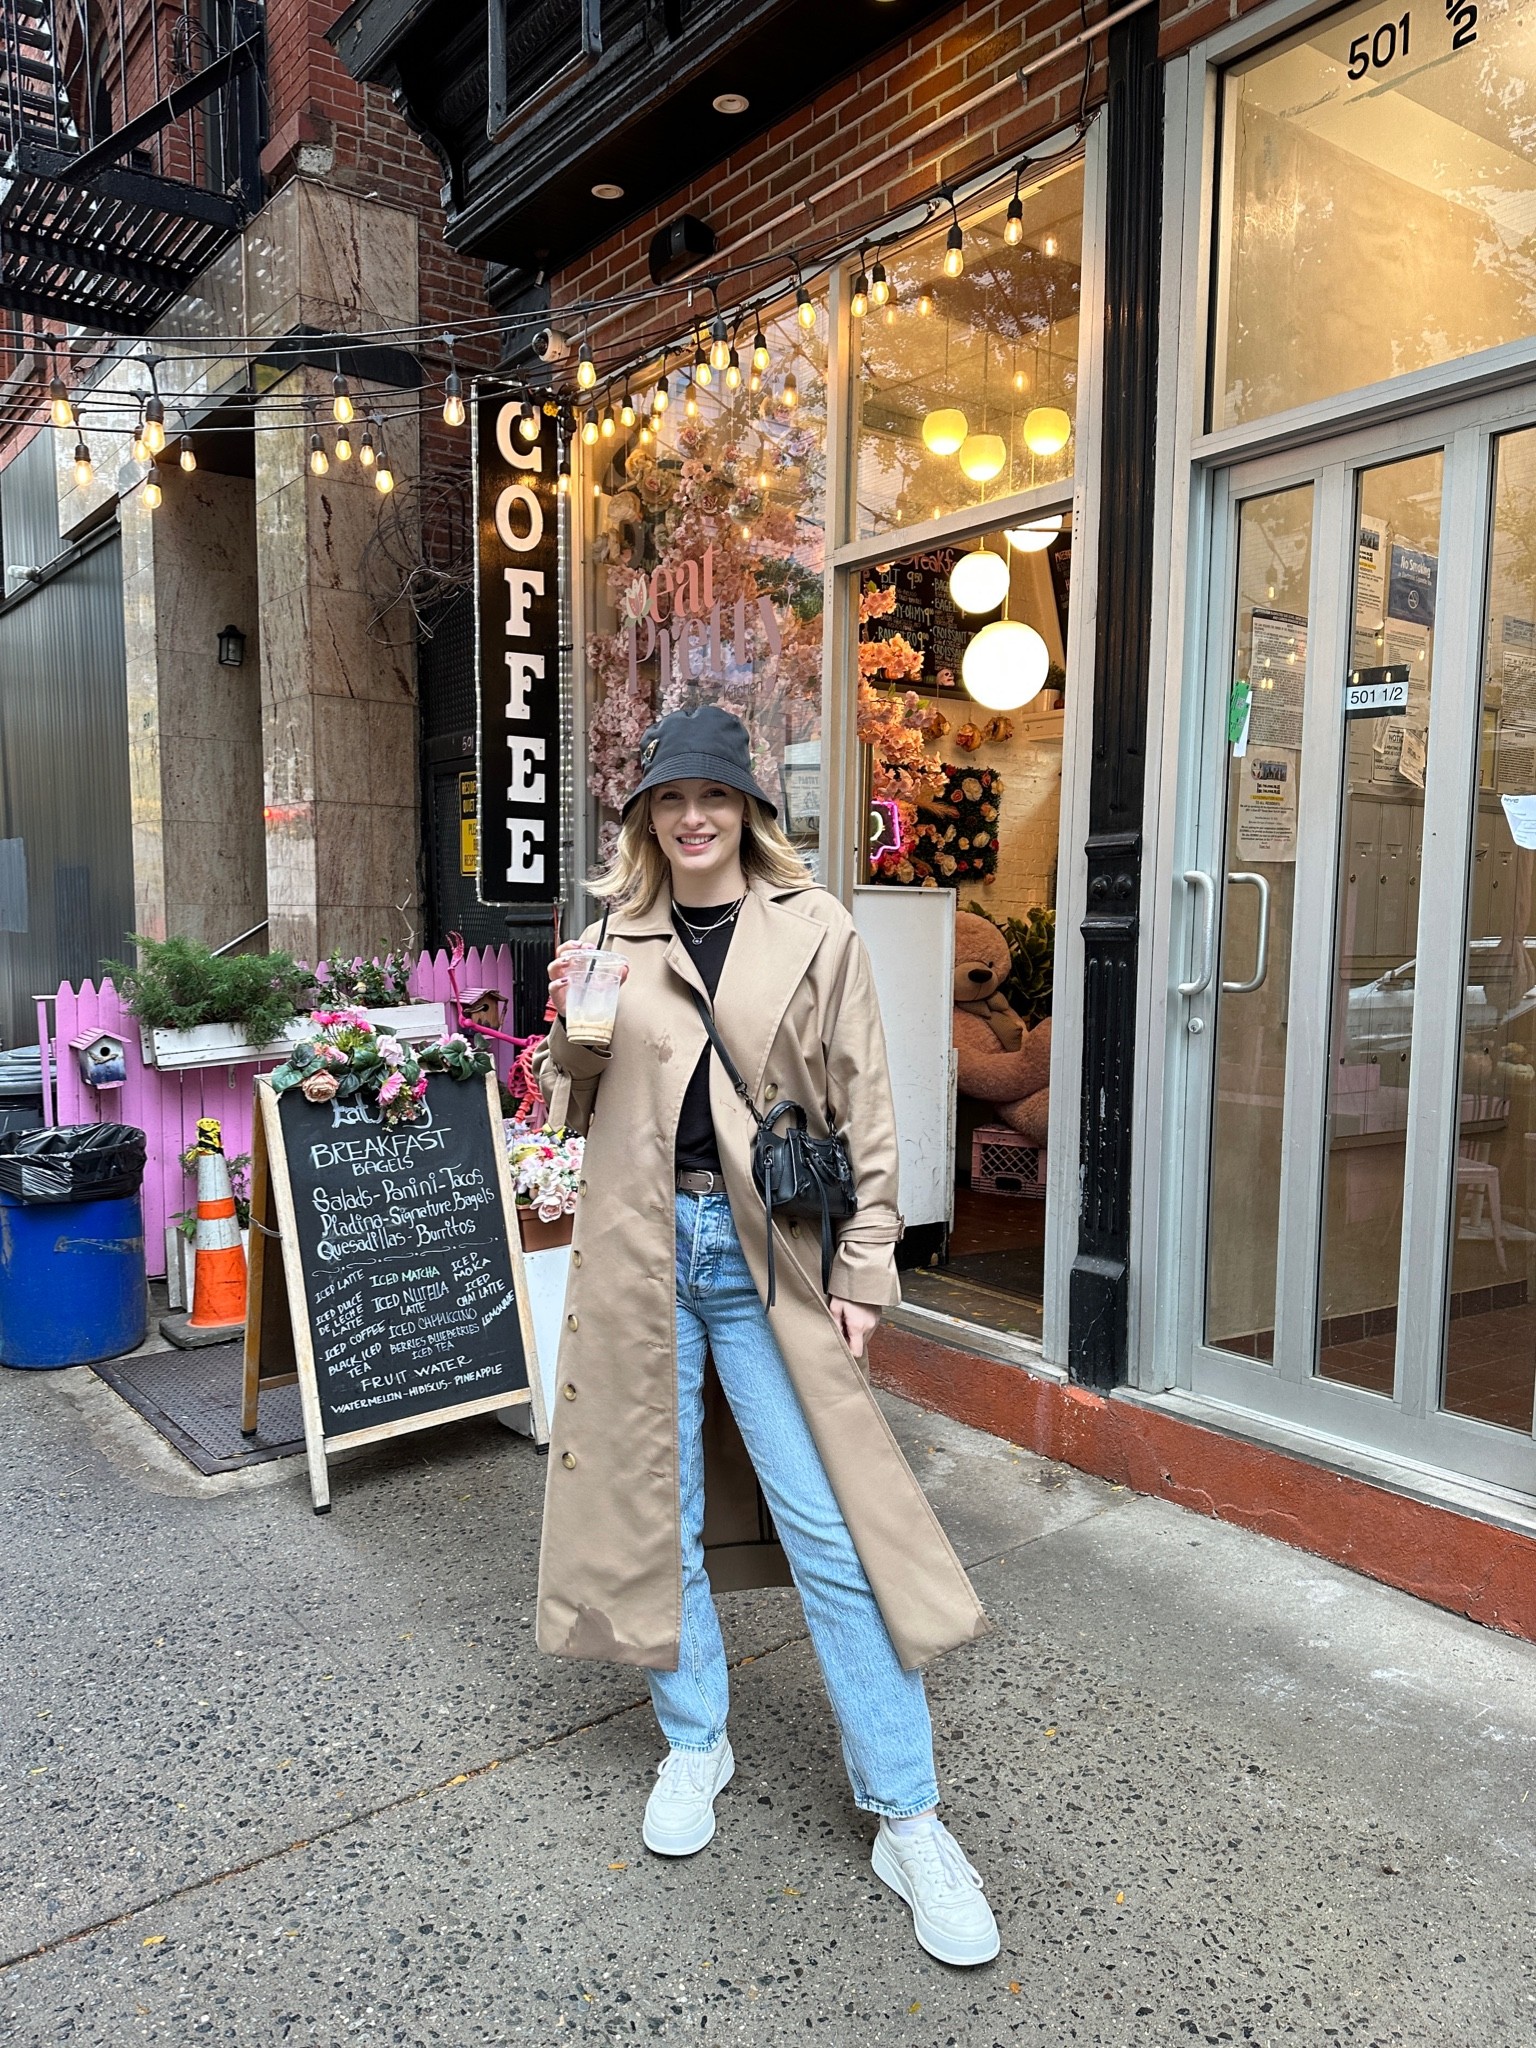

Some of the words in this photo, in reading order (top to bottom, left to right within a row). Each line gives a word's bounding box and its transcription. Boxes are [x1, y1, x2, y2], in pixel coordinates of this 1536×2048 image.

[1347, 11, 1410, 80] 501
[1446, 0, 1477, 50] /2
[649, 541, 718, 624] eat
[1409, 559, 1431, 579] Smoking
[495, 401, 546, 884] COFFEE
[627, 594, 782, 695] Pretty
[723, 680, 763, 702] Kitchen
[1350, 690, 1376, 704] 501
[1382, 687, 1403, 702] 1/2
[310, 1127, 452, 1169] BREAKFAST
[352, 1156, 414, 1177] BAGELS
[439, 1163, 484, 1189] Tacos
[389, 1200, 452, 1229] Signature
[452, 1187, 495, 1212] Bagels
[415, 1216, 476, 1247] Burritos
[451, 1252, 478, 1272] ICED
[453, 1258, 491, 1281] MOKA
[314, 1284, 336, 1304] ICED
[337, 1268, 365, 1290] LATTE
[369, 1273, 399, 1288] ICED
[401, 1266, 440, 1282] MATCHA
[464, 1273, 491, 1292] ICED
[371, 1294, 400, 1313] ICED
[402, 1281, 450, 1303] NUTELLA
[456, 1291, 477, 1307] CHAI
[479, 1278, 506, 1299] LATTE
[315, 1308, 336, 1326] ICED
[337, 1291, 363, 1314] DULCE
[318, 1323, 331, 1336] DE
[333, 1303, 364, 1327] LECHE
[400, 1301, 427, 1316] LATTE
[332, 1315, 365, 1337] LATTE
[388, 1321, 416, 1340] ICED
[418, 1308, 478, 1330] CAPPUCCINO
[324, 1342, 347, 1361] ICED
[349, 1319, 386, 1345] COFFEE
[389, 1337, 426, 1355] BERRIES
[411, 1346, 433, 1360] ICED
[434, 1340, 455, 1353] TEA
[328, 1354, 362, 1376] BLACK
[361, 1342, 382, 1360] ICED
[347, 1362, 372, 1378] TEA
[360, 1369, 407, 1392] FRUIT
[413, 1355, 473, 1378] WATER
[454, 1363, 503, 1386] PINEAPPLE
